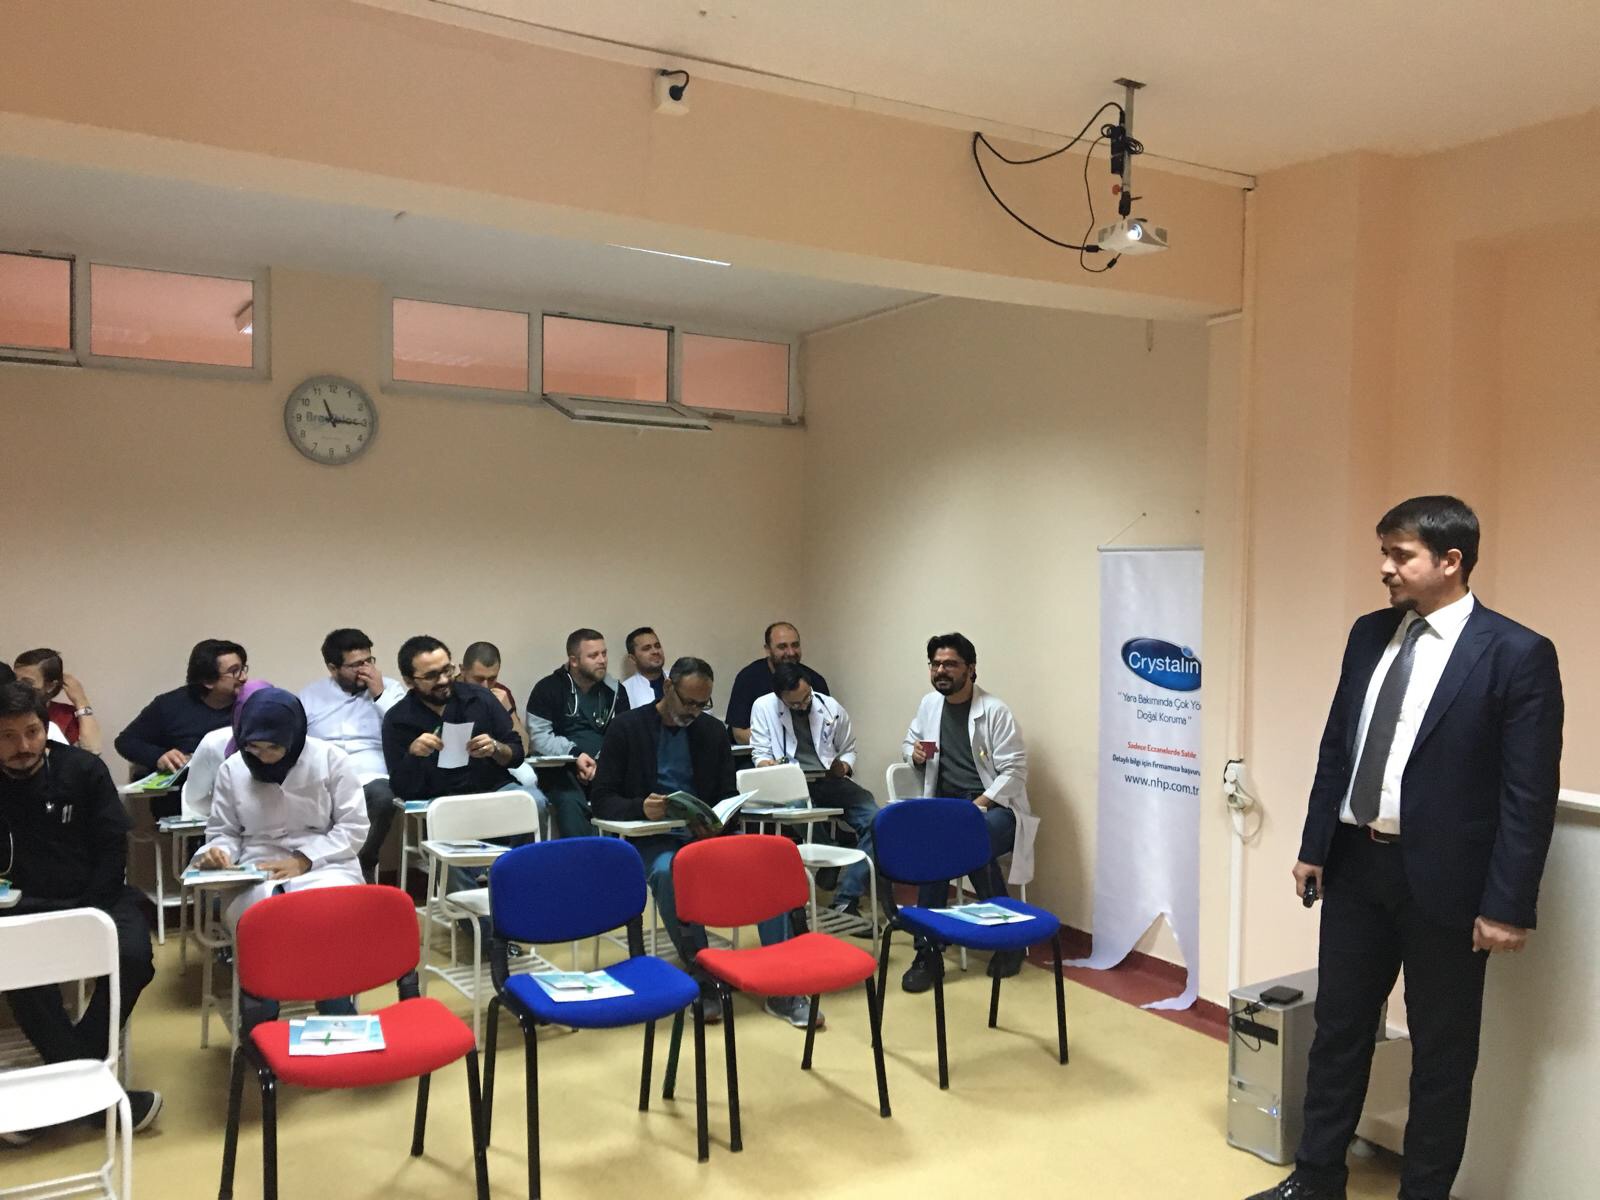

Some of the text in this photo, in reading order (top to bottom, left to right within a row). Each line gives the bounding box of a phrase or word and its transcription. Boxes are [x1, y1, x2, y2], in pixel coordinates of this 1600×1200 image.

[1128, 651, 1199, 674] Crystalin
[1174, 698, 1189, 711] Çok
[1136, 709, 1157, 723] Doğal
[1124, 774, 1200, 796] www.nhp.com.tr
